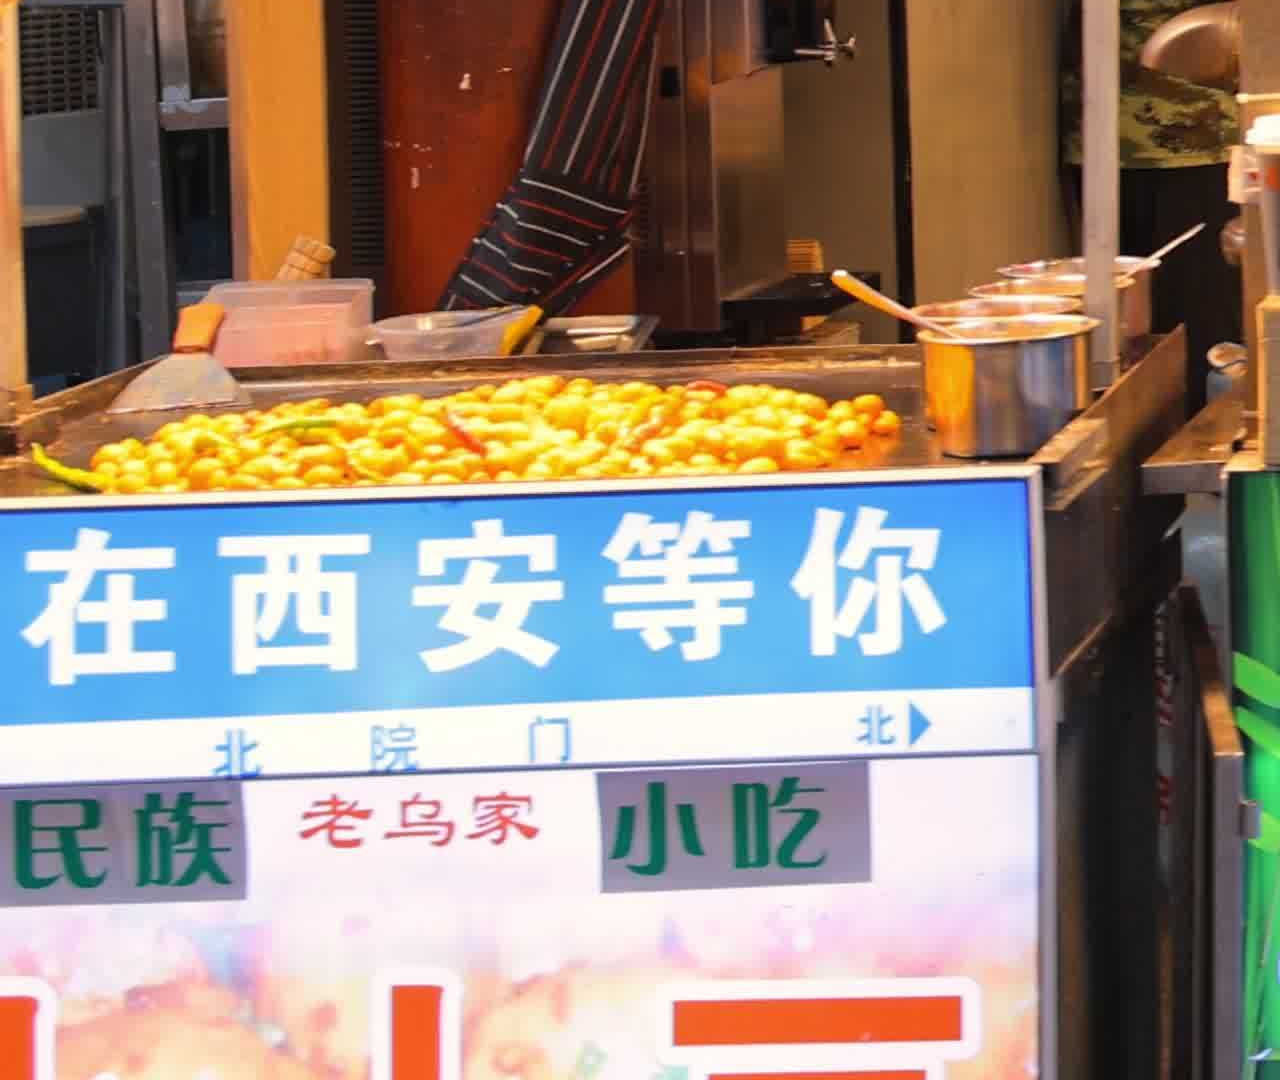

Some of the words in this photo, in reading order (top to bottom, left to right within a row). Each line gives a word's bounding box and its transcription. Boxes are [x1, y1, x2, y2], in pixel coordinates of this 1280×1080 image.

[20, 506, 948, 687] 在西安等你
[212, 716, 572, 781] 北院门
[856, 703, 896, 746] 北
[12, 791, 234, 891] 民族
[299, 790, 540, 849] 老乌家
[609, 775, 827, 881] 小吃
